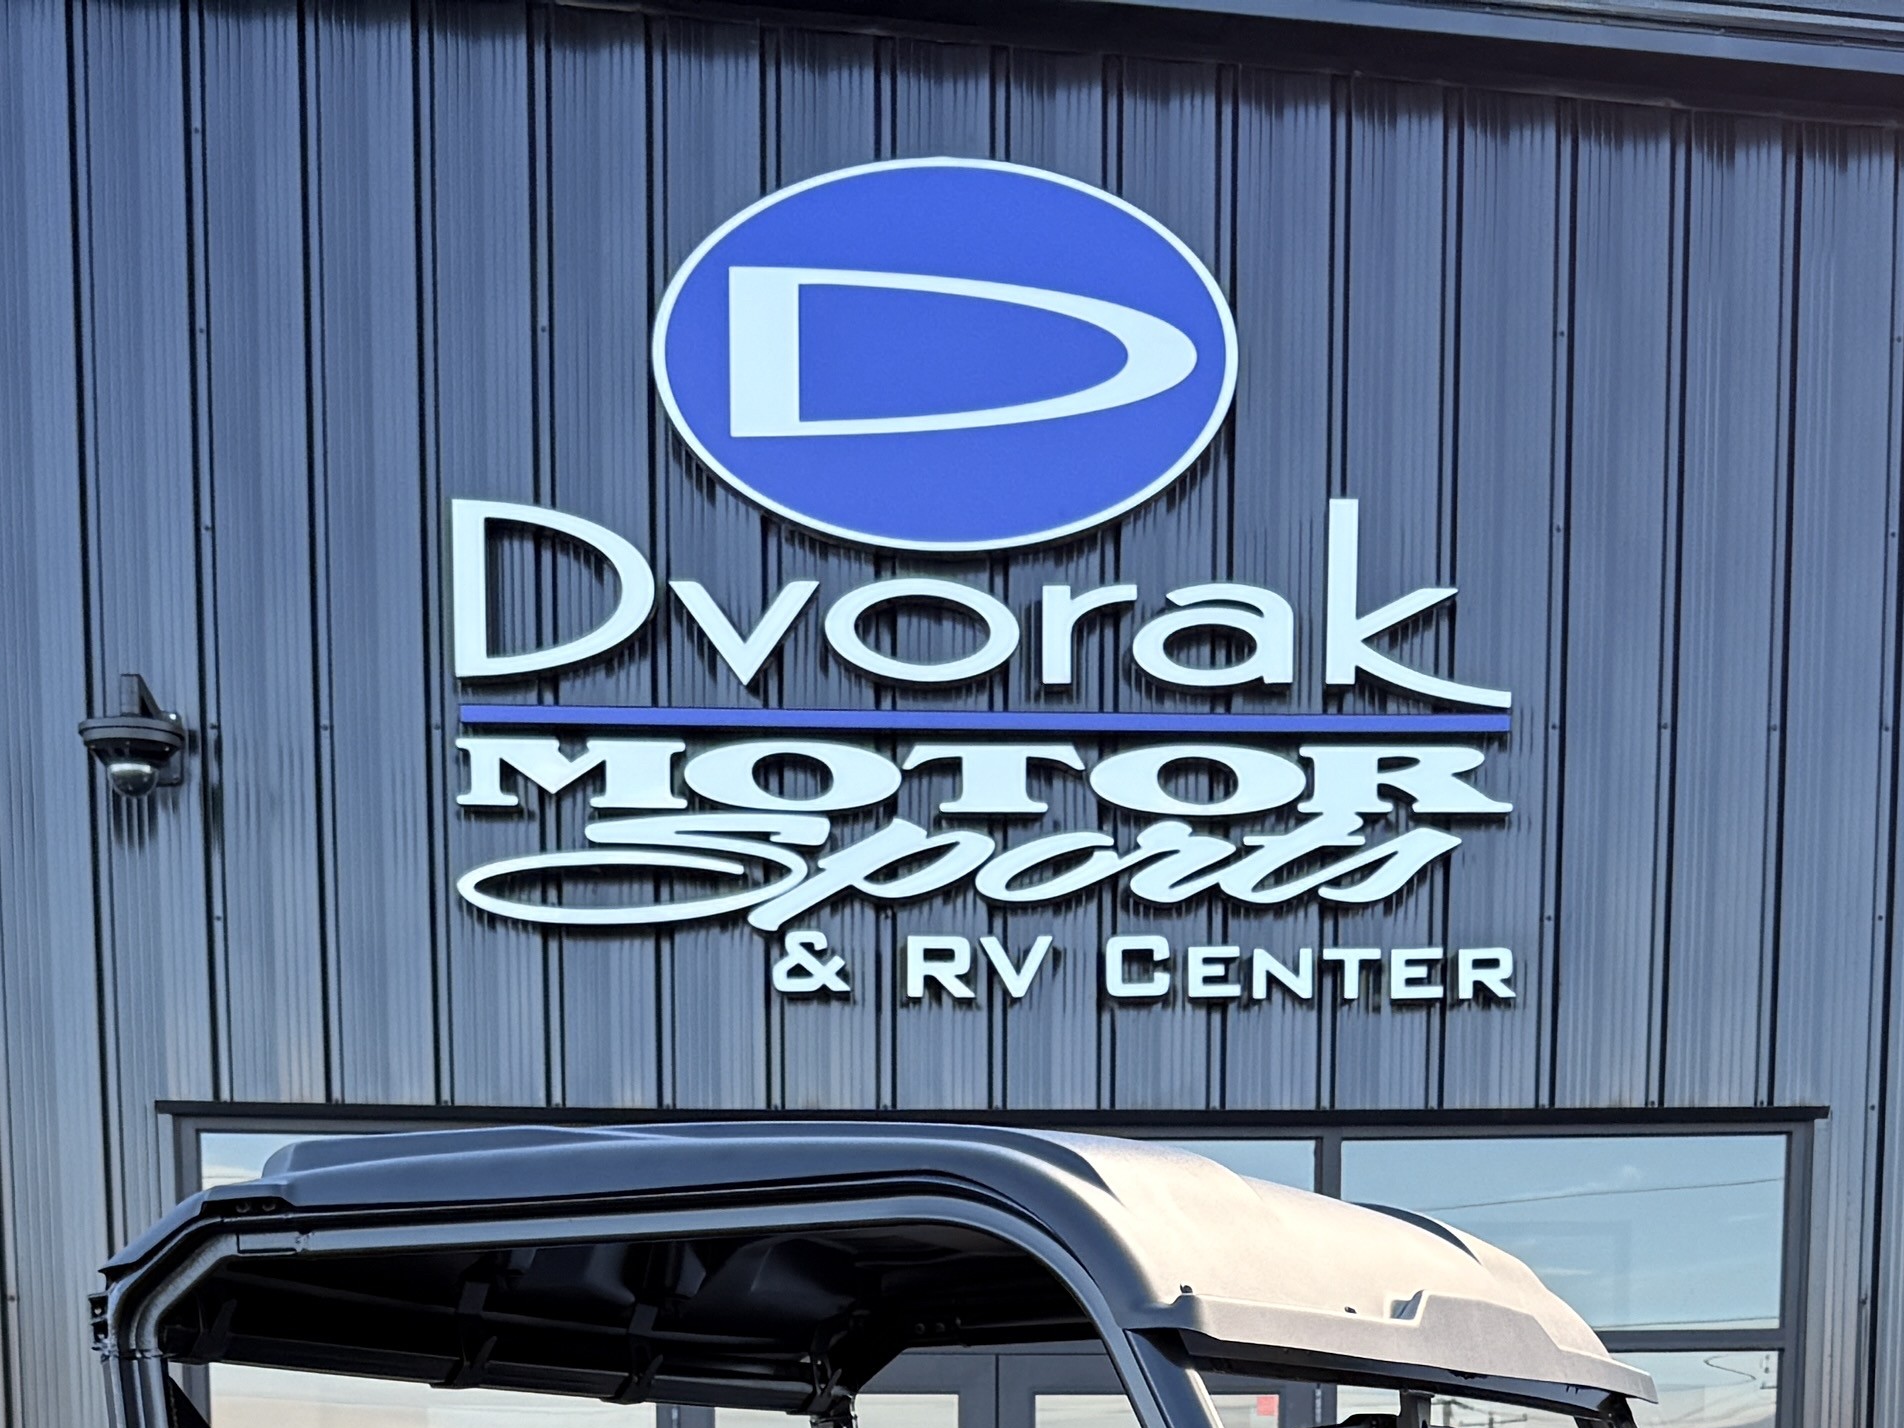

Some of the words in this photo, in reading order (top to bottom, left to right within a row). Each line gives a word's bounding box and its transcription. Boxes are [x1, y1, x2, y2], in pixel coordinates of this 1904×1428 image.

[729, 265, 1198, 438] D
[451, 498, 1513, 709] Dvorak
[455, 737, 1514, 816] MOTOR
[456, 812, 1463, 932] Sports
[772, 930, 850, 997] &
[907, 936, 1053, 1000] RV
[1105, 935, 1516, 1001] CENTER
